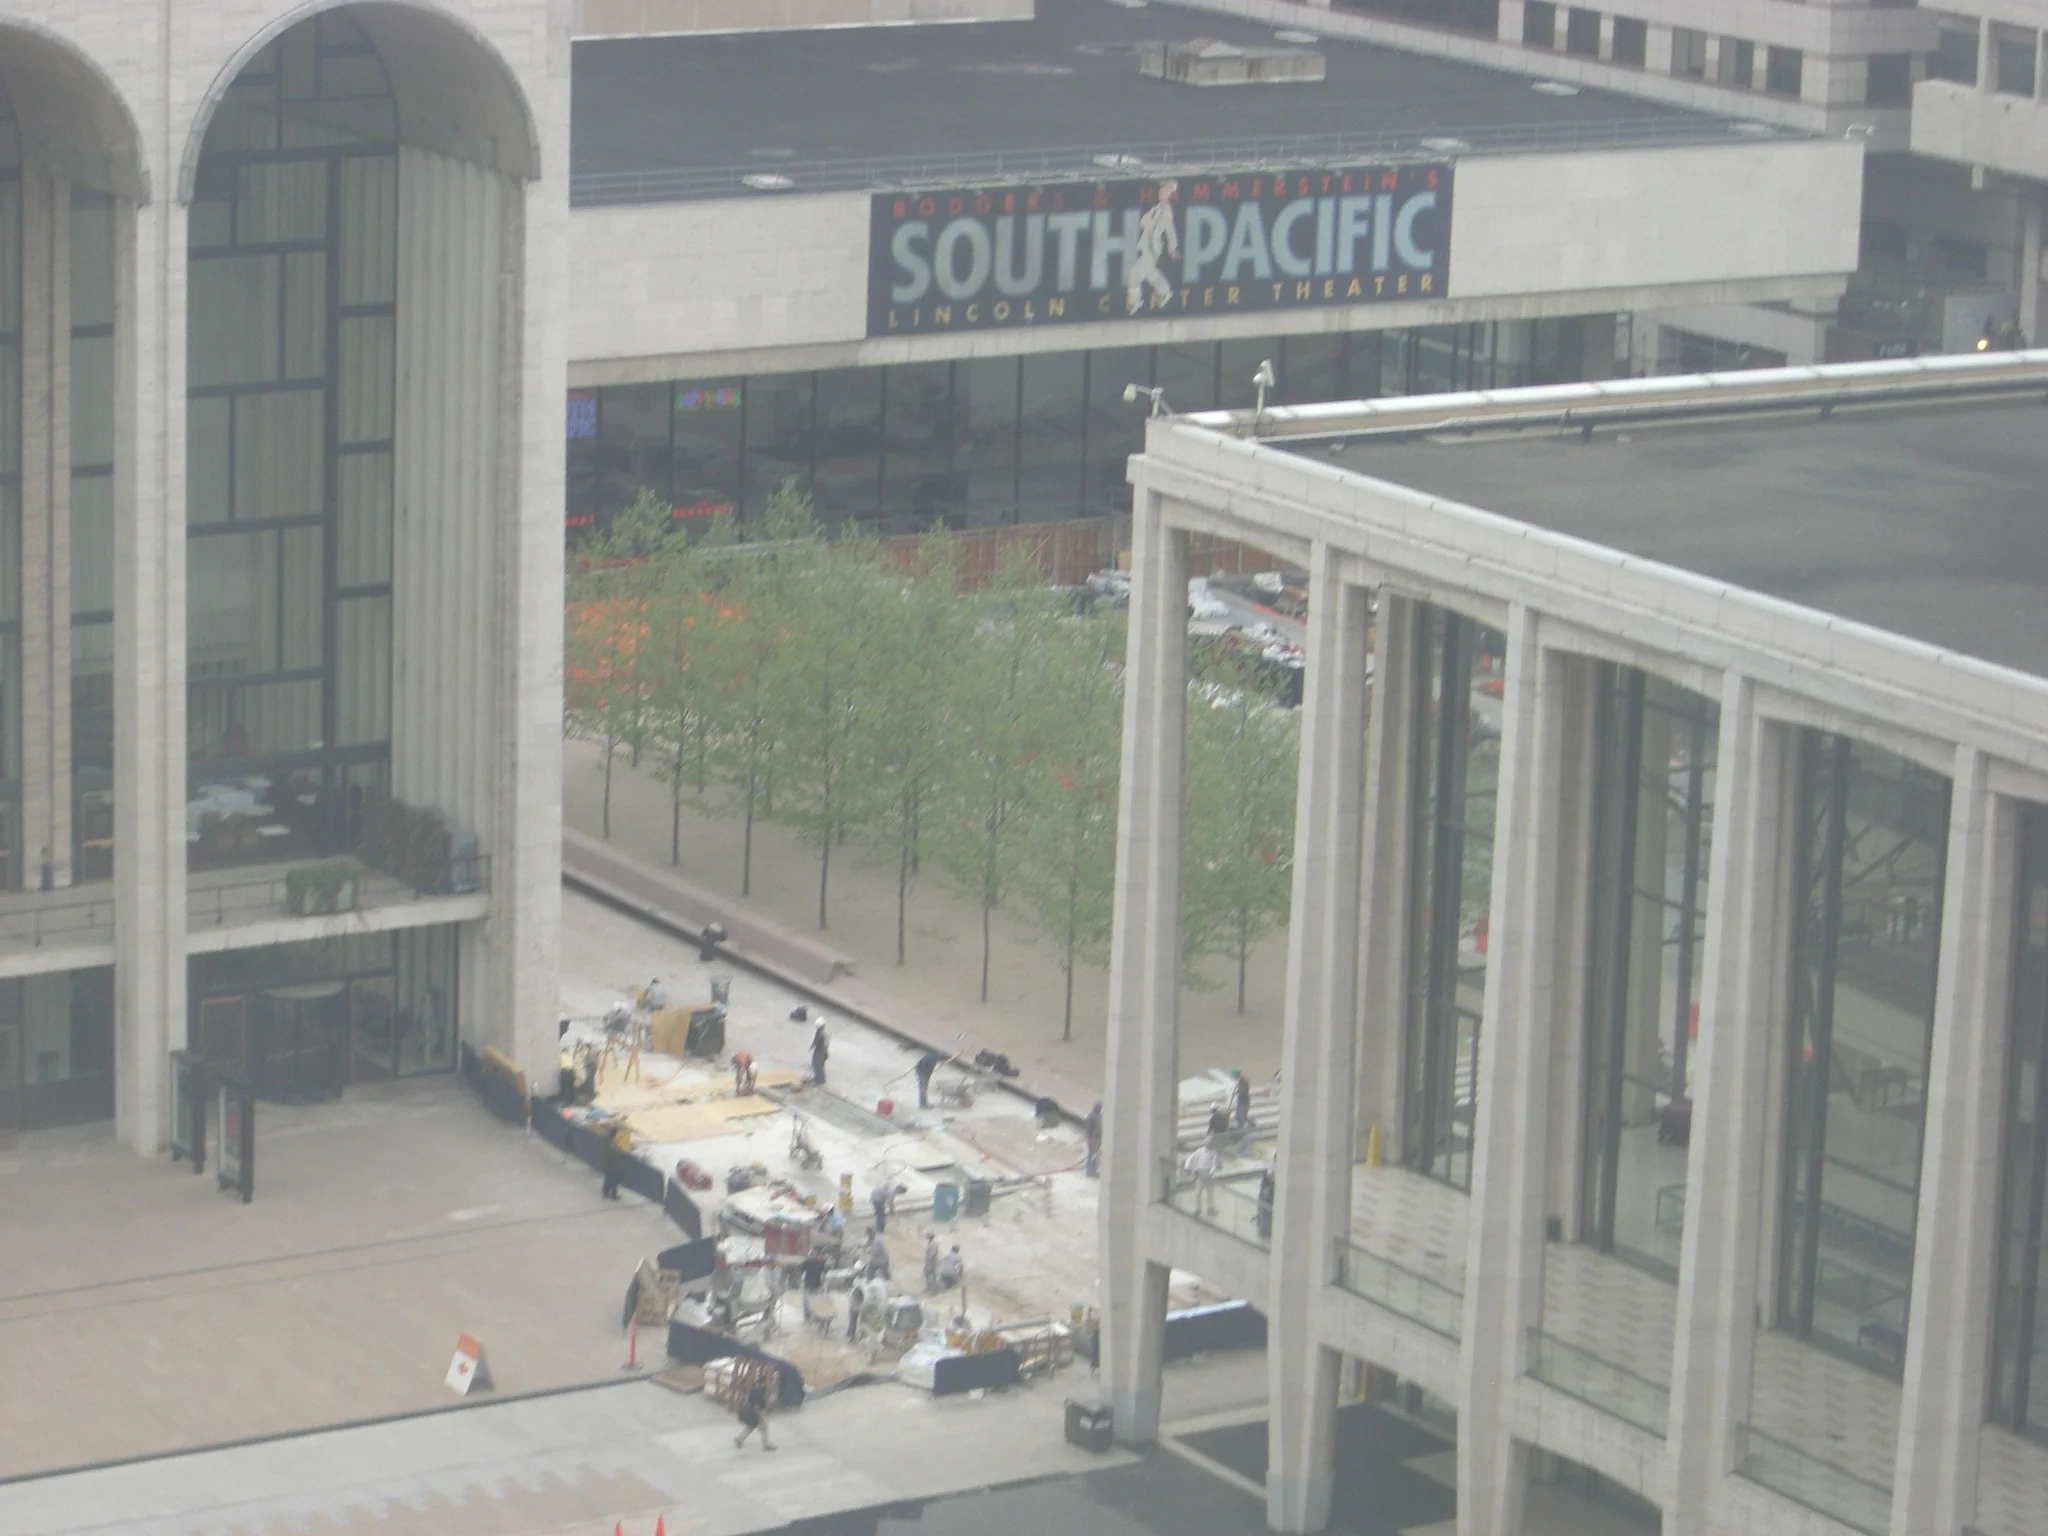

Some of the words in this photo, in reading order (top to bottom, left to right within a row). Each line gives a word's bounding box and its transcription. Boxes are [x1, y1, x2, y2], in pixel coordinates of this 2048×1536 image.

[890, 208, 1142, 303] SOUTH
[1181, 190, 1438, 285] PACIFIC
[889, 297, 1065, 328] LINCOLN
[1272, 273, 1433, 302] THEATER
